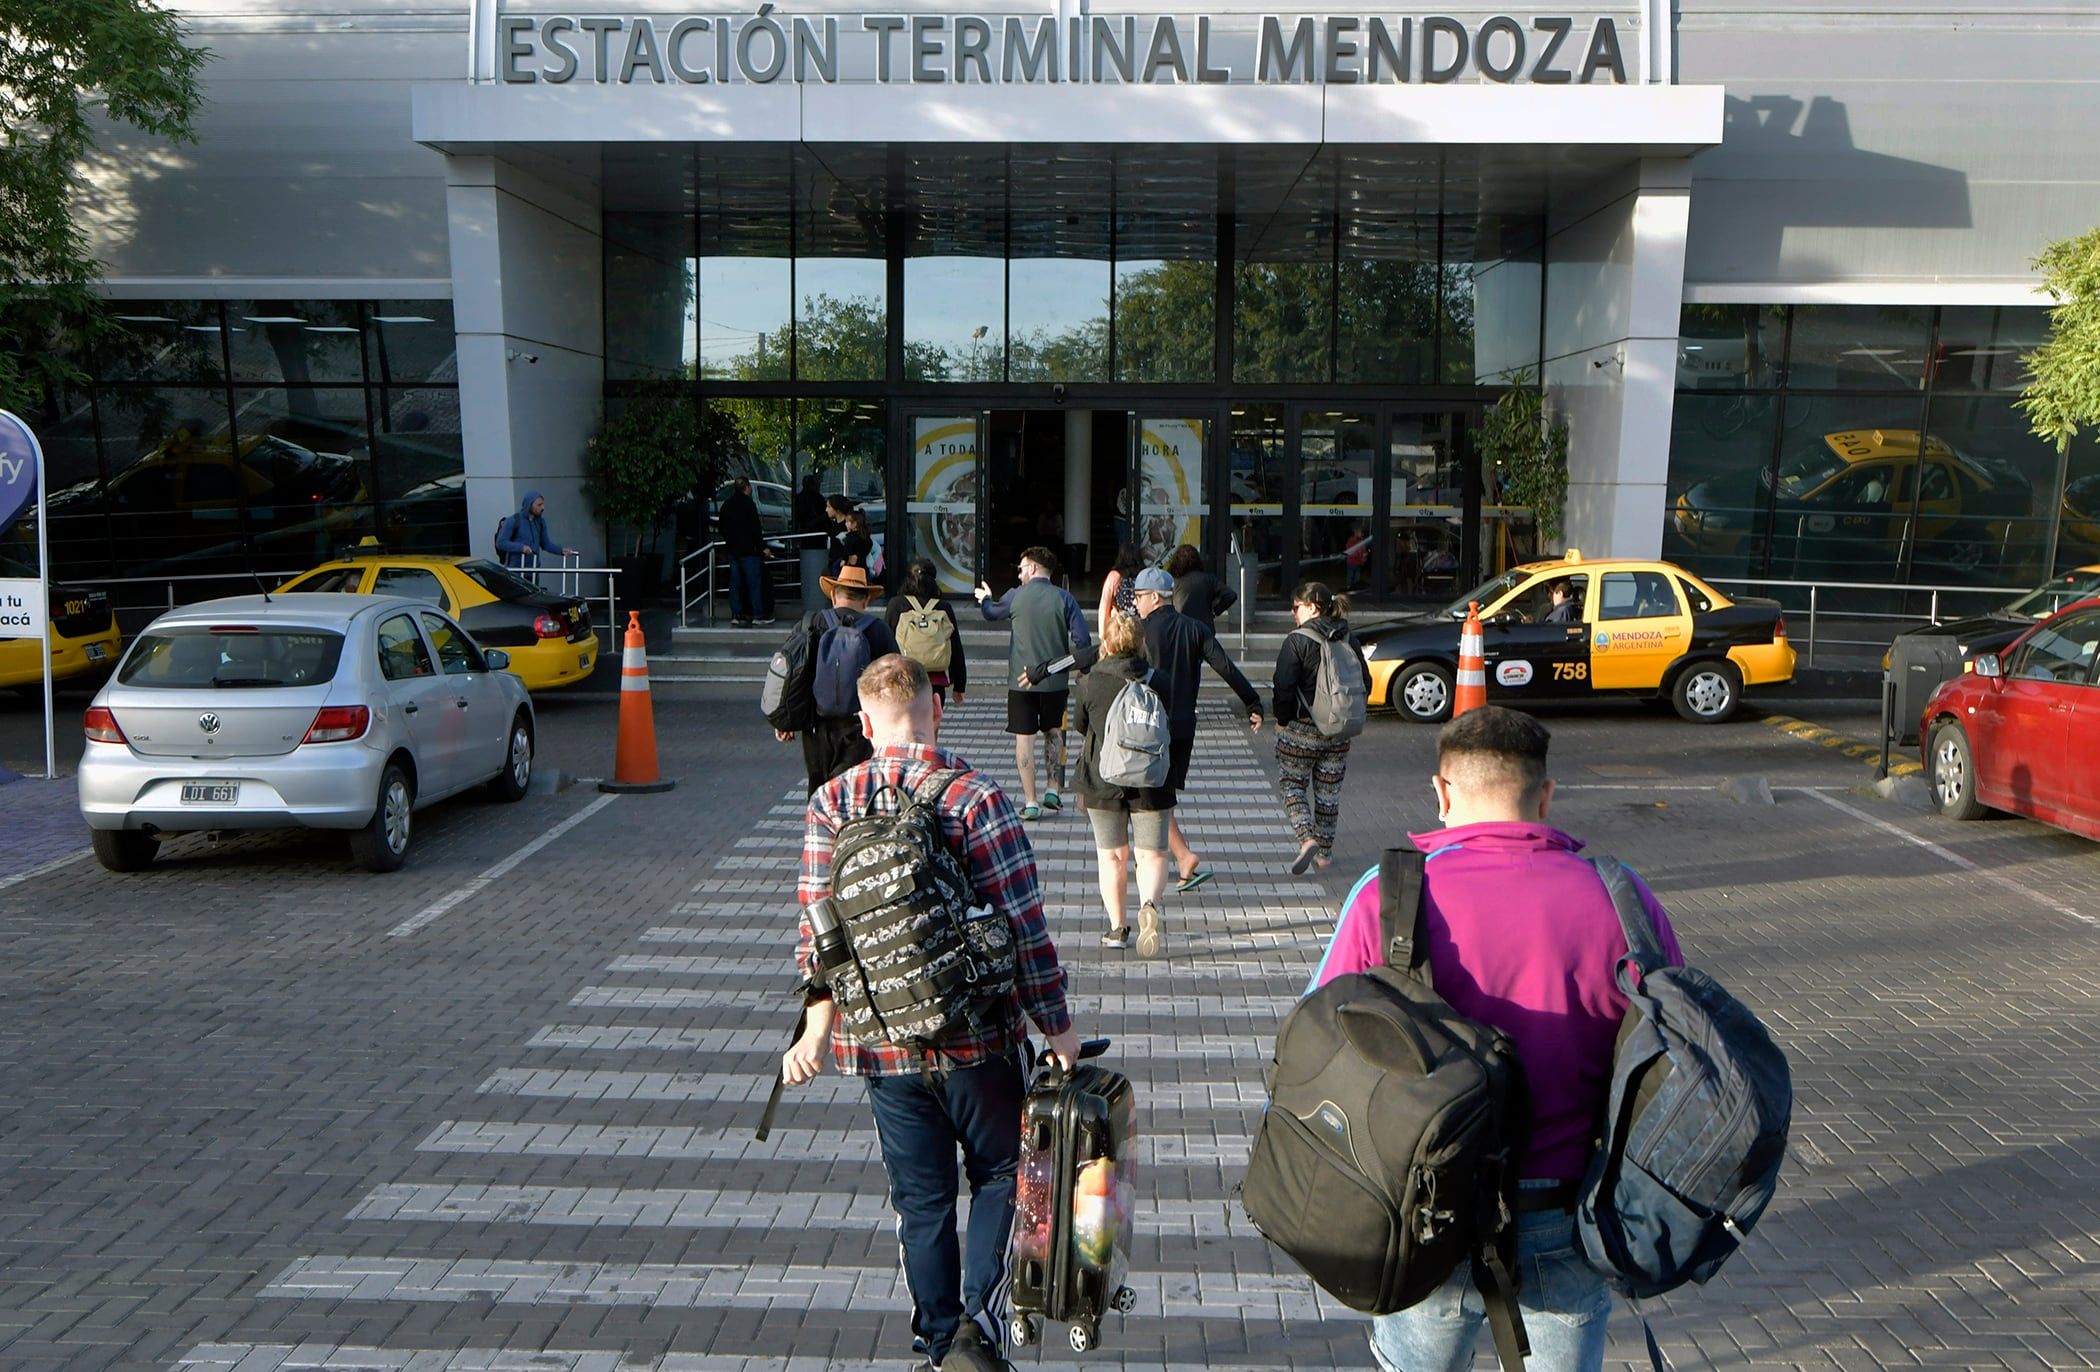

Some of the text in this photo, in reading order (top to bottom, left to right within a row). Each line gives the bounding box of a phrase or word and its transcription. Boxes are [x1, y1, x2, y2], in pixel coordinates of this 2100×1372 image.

[502, 3, 1627, 84] ESTACIÓN TERMINAL MENDOZA
[924, 443, 976, 455] A TODA
[1142, 444, 1180, 456] HORA
[7, 594, 22, 607] tu
[64, 599, 85, 616] 1021
[0, 612, 31, 625] acá
[1612, 630, 1663, 641] MENDOZA
[1612, 640, 1664, 650] ARGENTINA
[1552, 662, 1587, 681] 758
[181, 785, 235, 800] LDI 661
